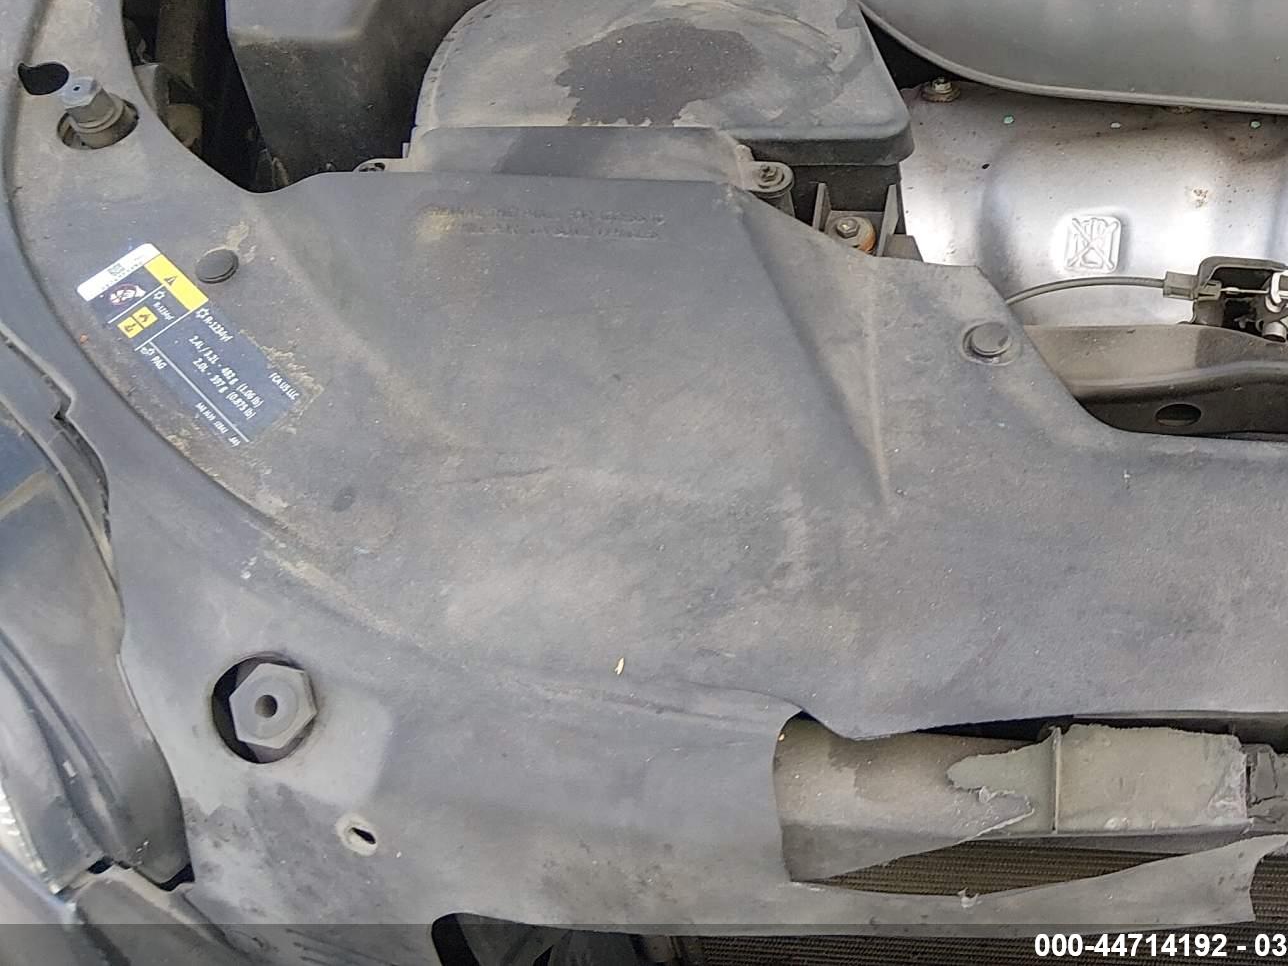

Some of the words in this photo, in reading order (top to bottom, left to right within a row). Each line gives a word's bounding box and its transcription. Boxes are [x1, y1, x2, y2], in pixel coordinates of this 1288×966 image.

[202, 315, 233, 344] R-1234yf
[150, 355, 167, 370] PAG
[192, 357, 209, 372] 2.0L
